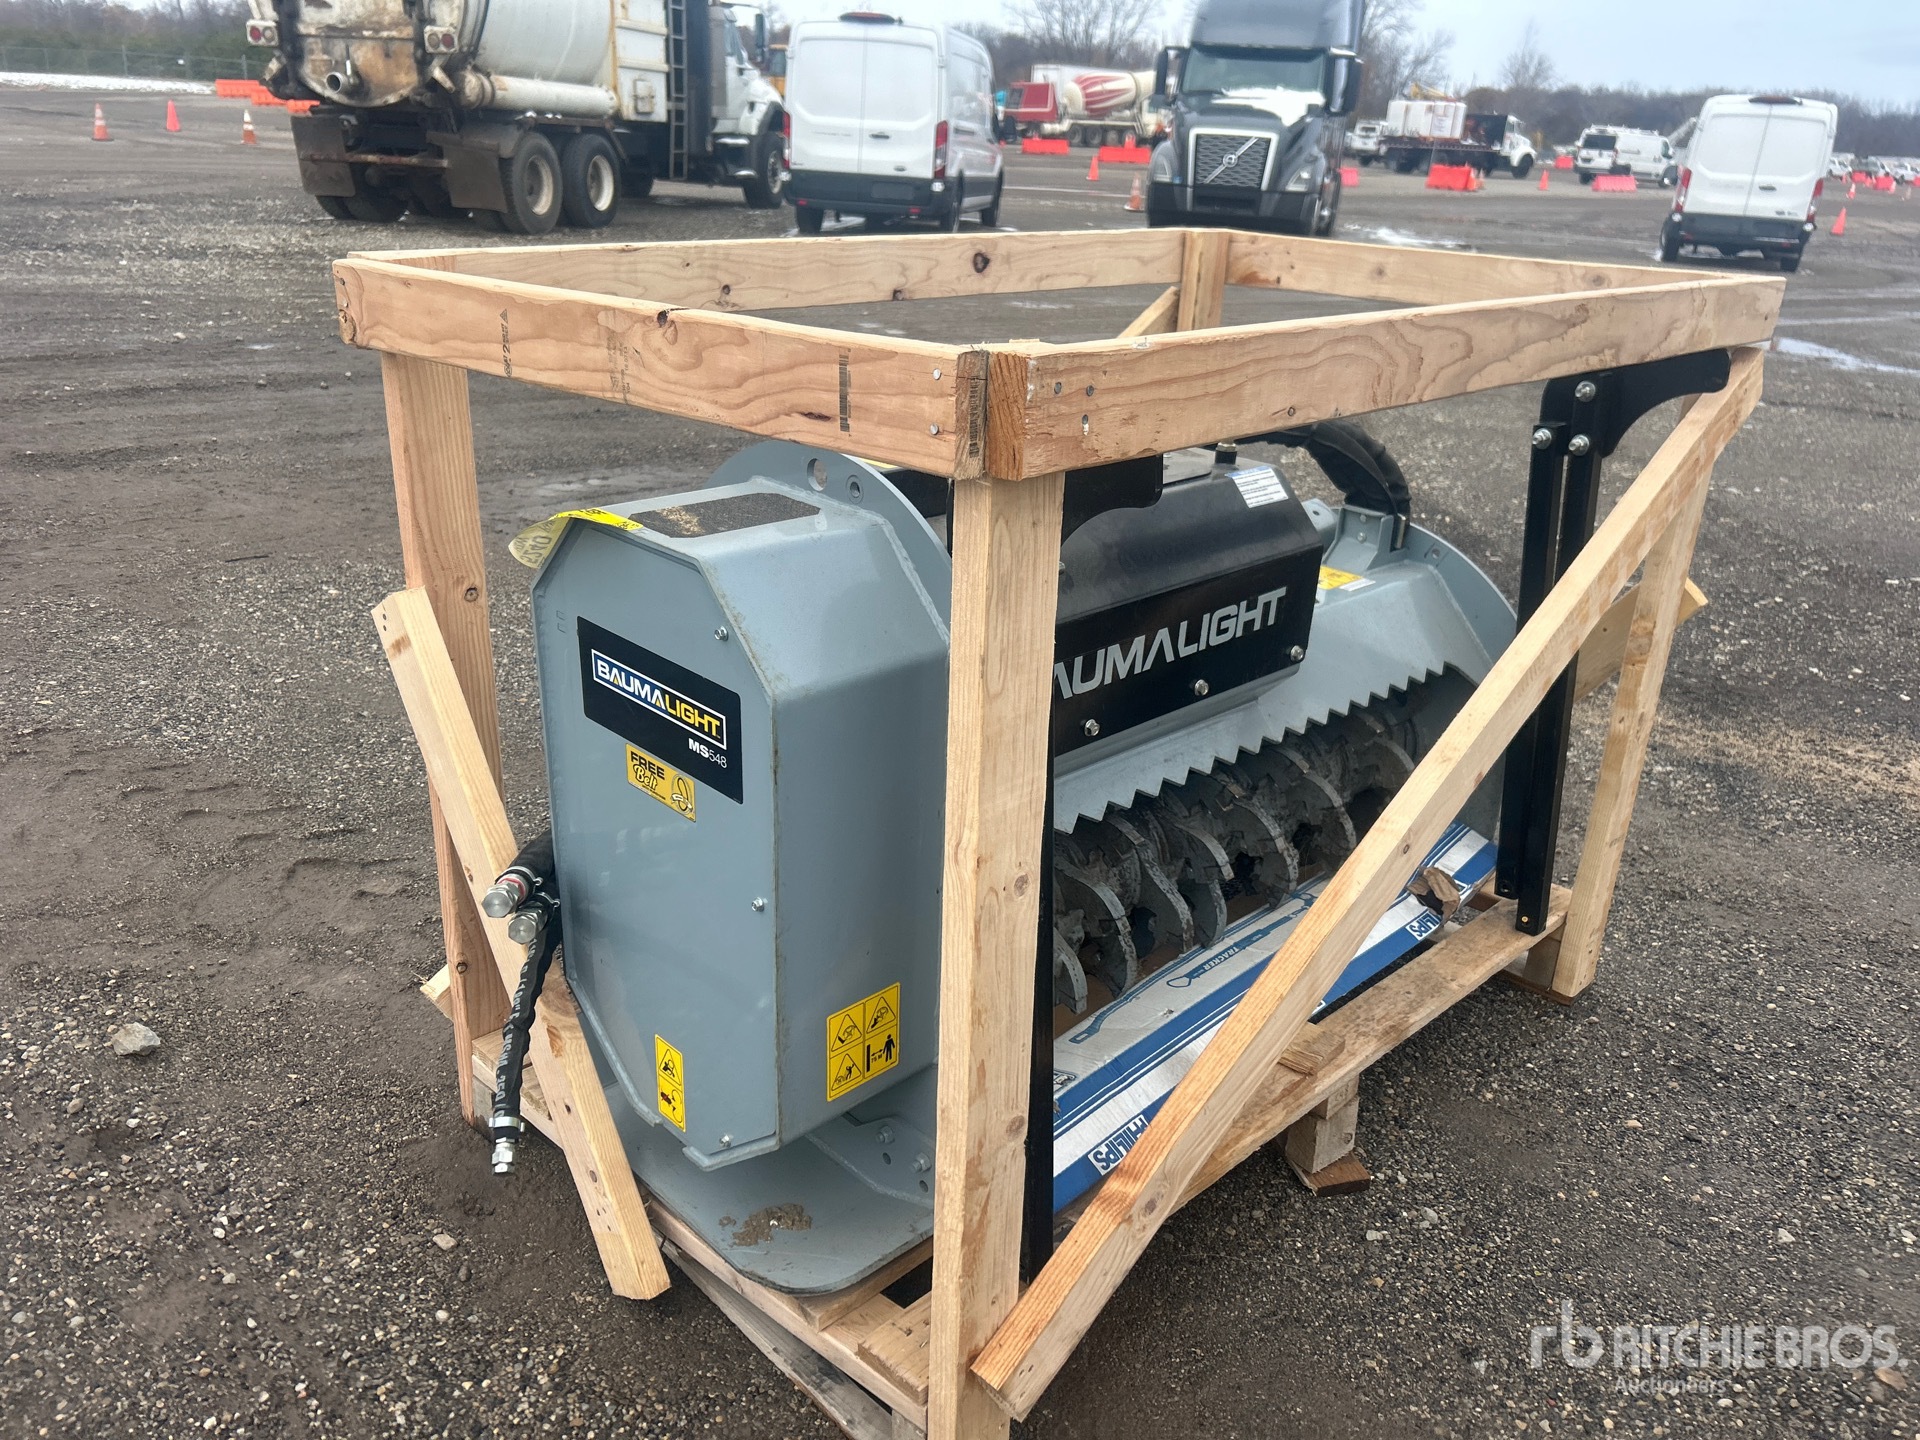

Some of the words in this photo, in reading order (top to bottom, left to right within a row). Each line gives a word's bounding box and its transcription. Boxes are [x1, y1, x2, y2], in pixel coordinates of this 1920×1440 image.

[1054, 586, 1288, 700] AUMALIGHT
[597, 659, 721, 737] BAUMALIGHT
[630, 750, 665, 780] FREE
[688, 738, 728, 769] MS548
[633, 763, 658, 791] Belt
[1203, 946, 1240, 972] TRACKER
